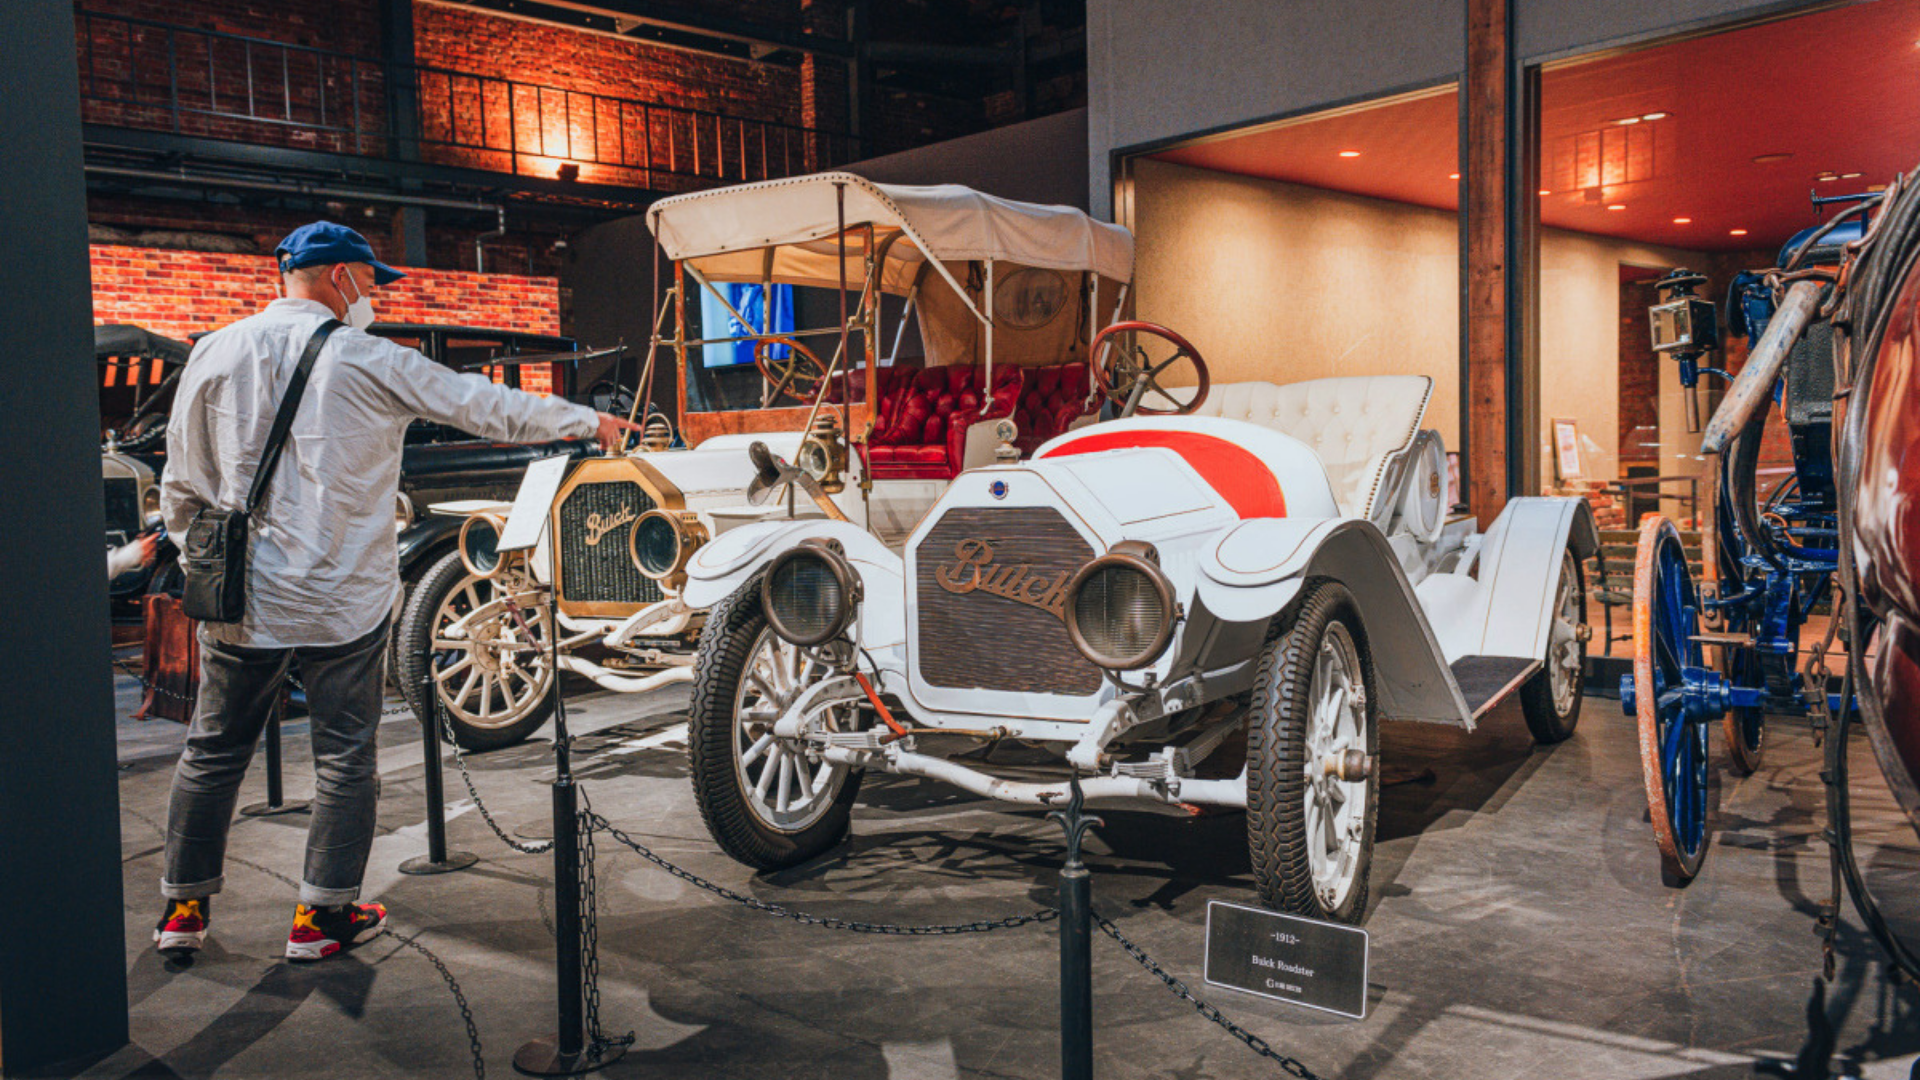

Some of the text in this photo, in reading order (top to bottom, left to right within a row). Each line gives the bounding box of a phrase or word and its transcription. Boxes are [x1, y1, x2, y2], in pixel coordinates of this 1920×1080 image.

[585, 501, 636, 546] Buick
[935, 538, 1071, 619] Buick
[1252, 955, 1314, 977] Buick Roadster
